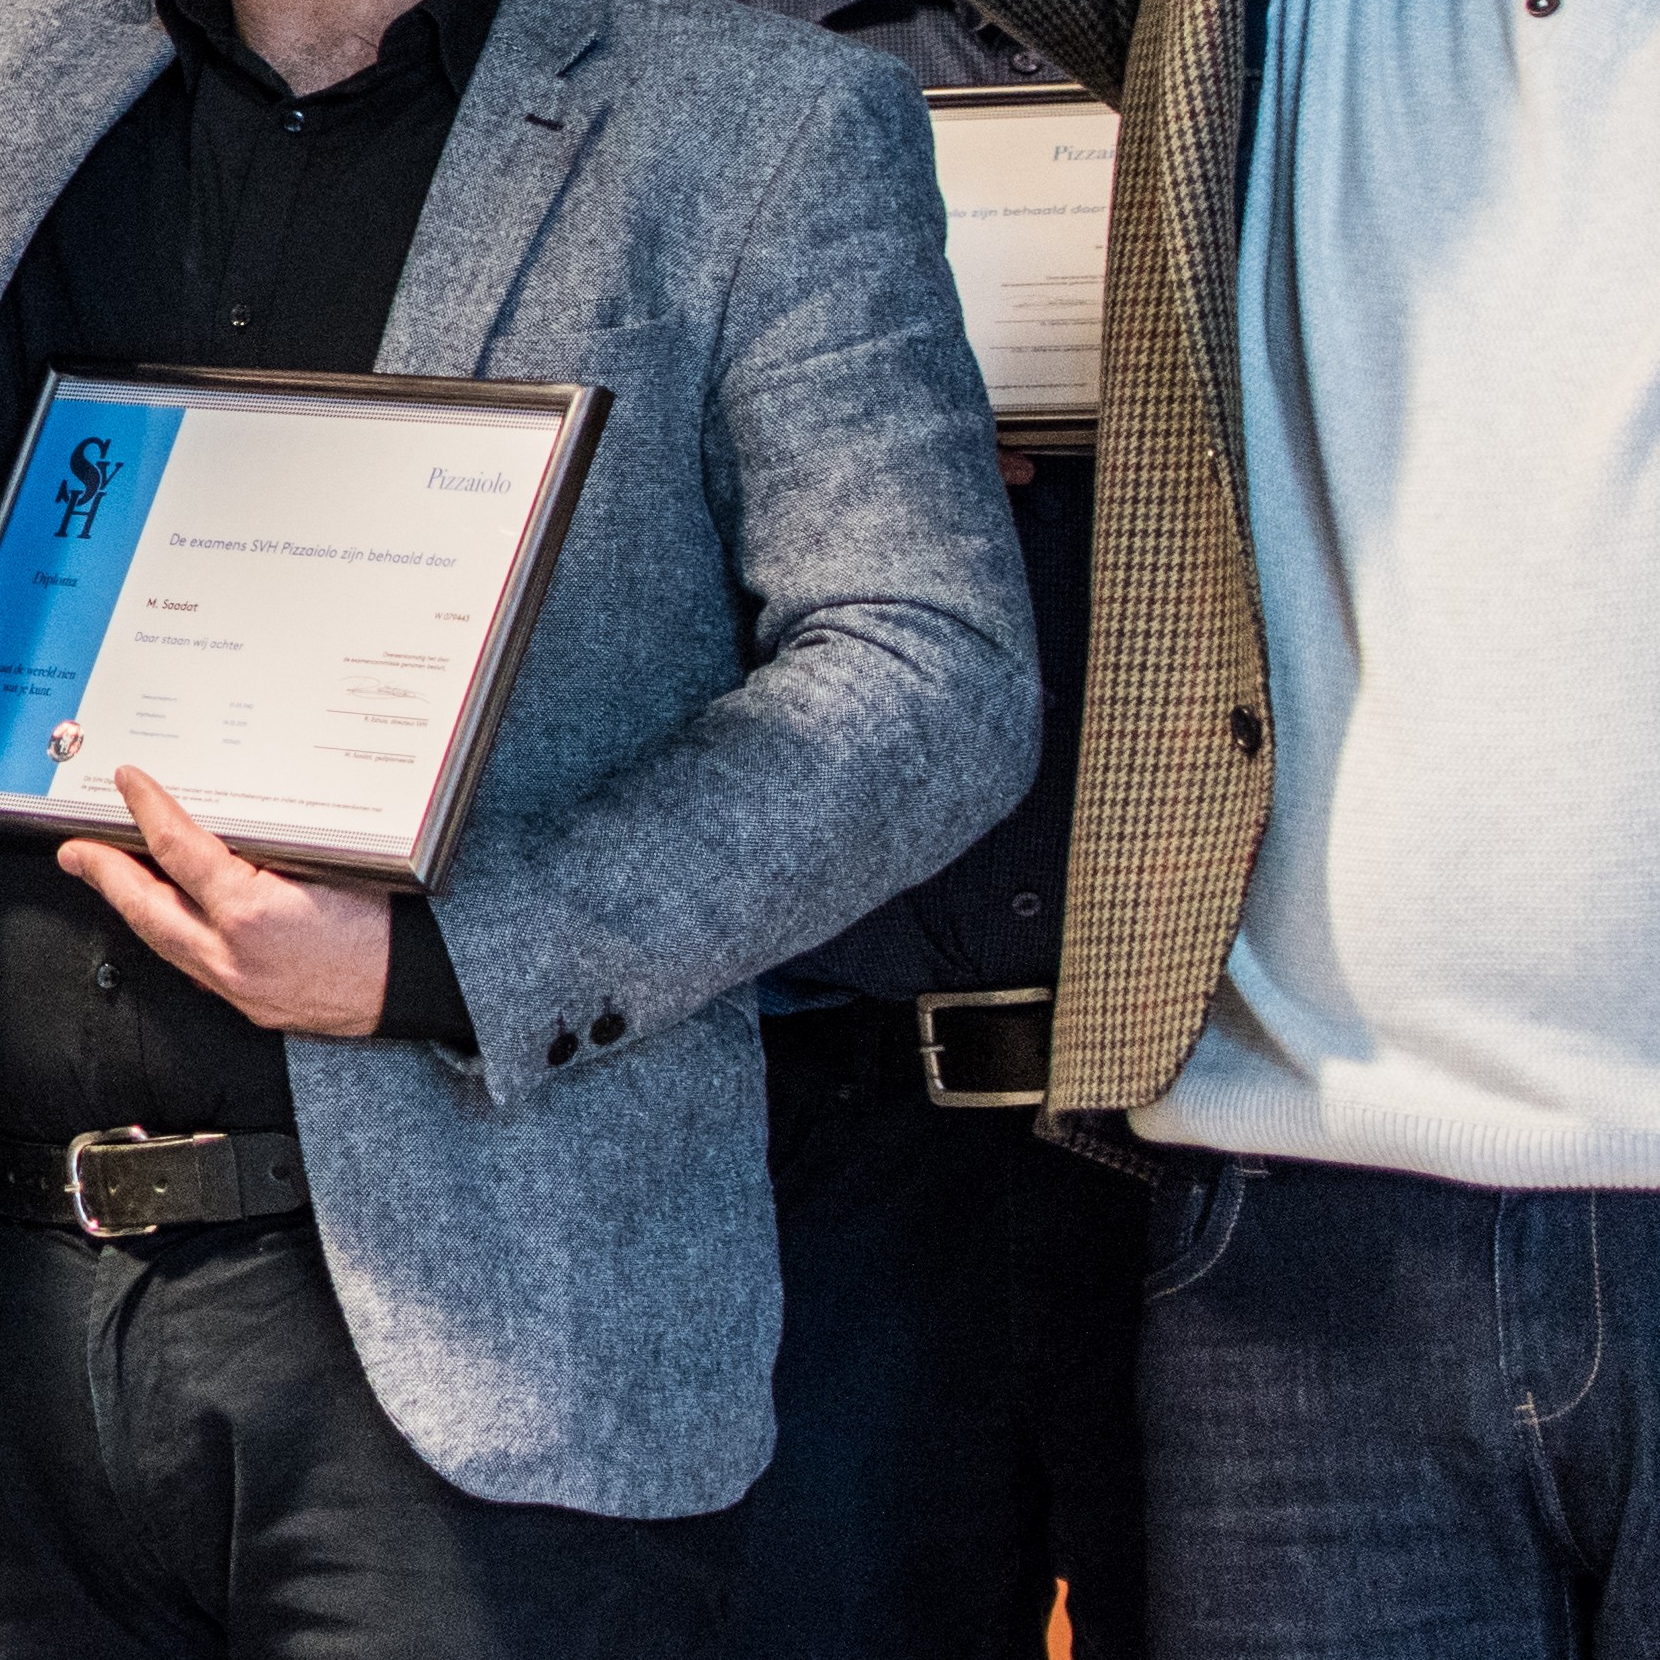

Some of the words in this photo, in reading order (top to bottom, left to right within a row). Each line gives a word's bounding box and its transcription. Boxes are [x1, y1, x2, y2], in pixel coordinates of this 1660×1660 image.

[1053, 144, 1116, 161] Pizzai
[1003, 204, 1068, 217] behaald
[1071, 204, 1106, 214] door
[426, 467, 512, 494] Pizzaiolo
[169, 533, 187, 547] De
[190, 536, 248, 552] examens
[250, 539, 279, 554] SVH
[280, 542, 338, 559] Pizzaiolo
[341, 547, 364, 563] zijn
[367, 548, 423, 565] behaald
[426, 553, 457, 568] door
[32, 571, 78, 589] Diploma
[146, 598, 158, 608] M.
[162, 599, 199, 612] Saadat
[134, 631, 159, 643] Daar
[161, 635, 190, 646] staan
[193, 638, 208, 650] wij
[209, 639, 244, 651] achter
[26, 666, 57, 678] wereld
[57, 669, 76, 680] zien
